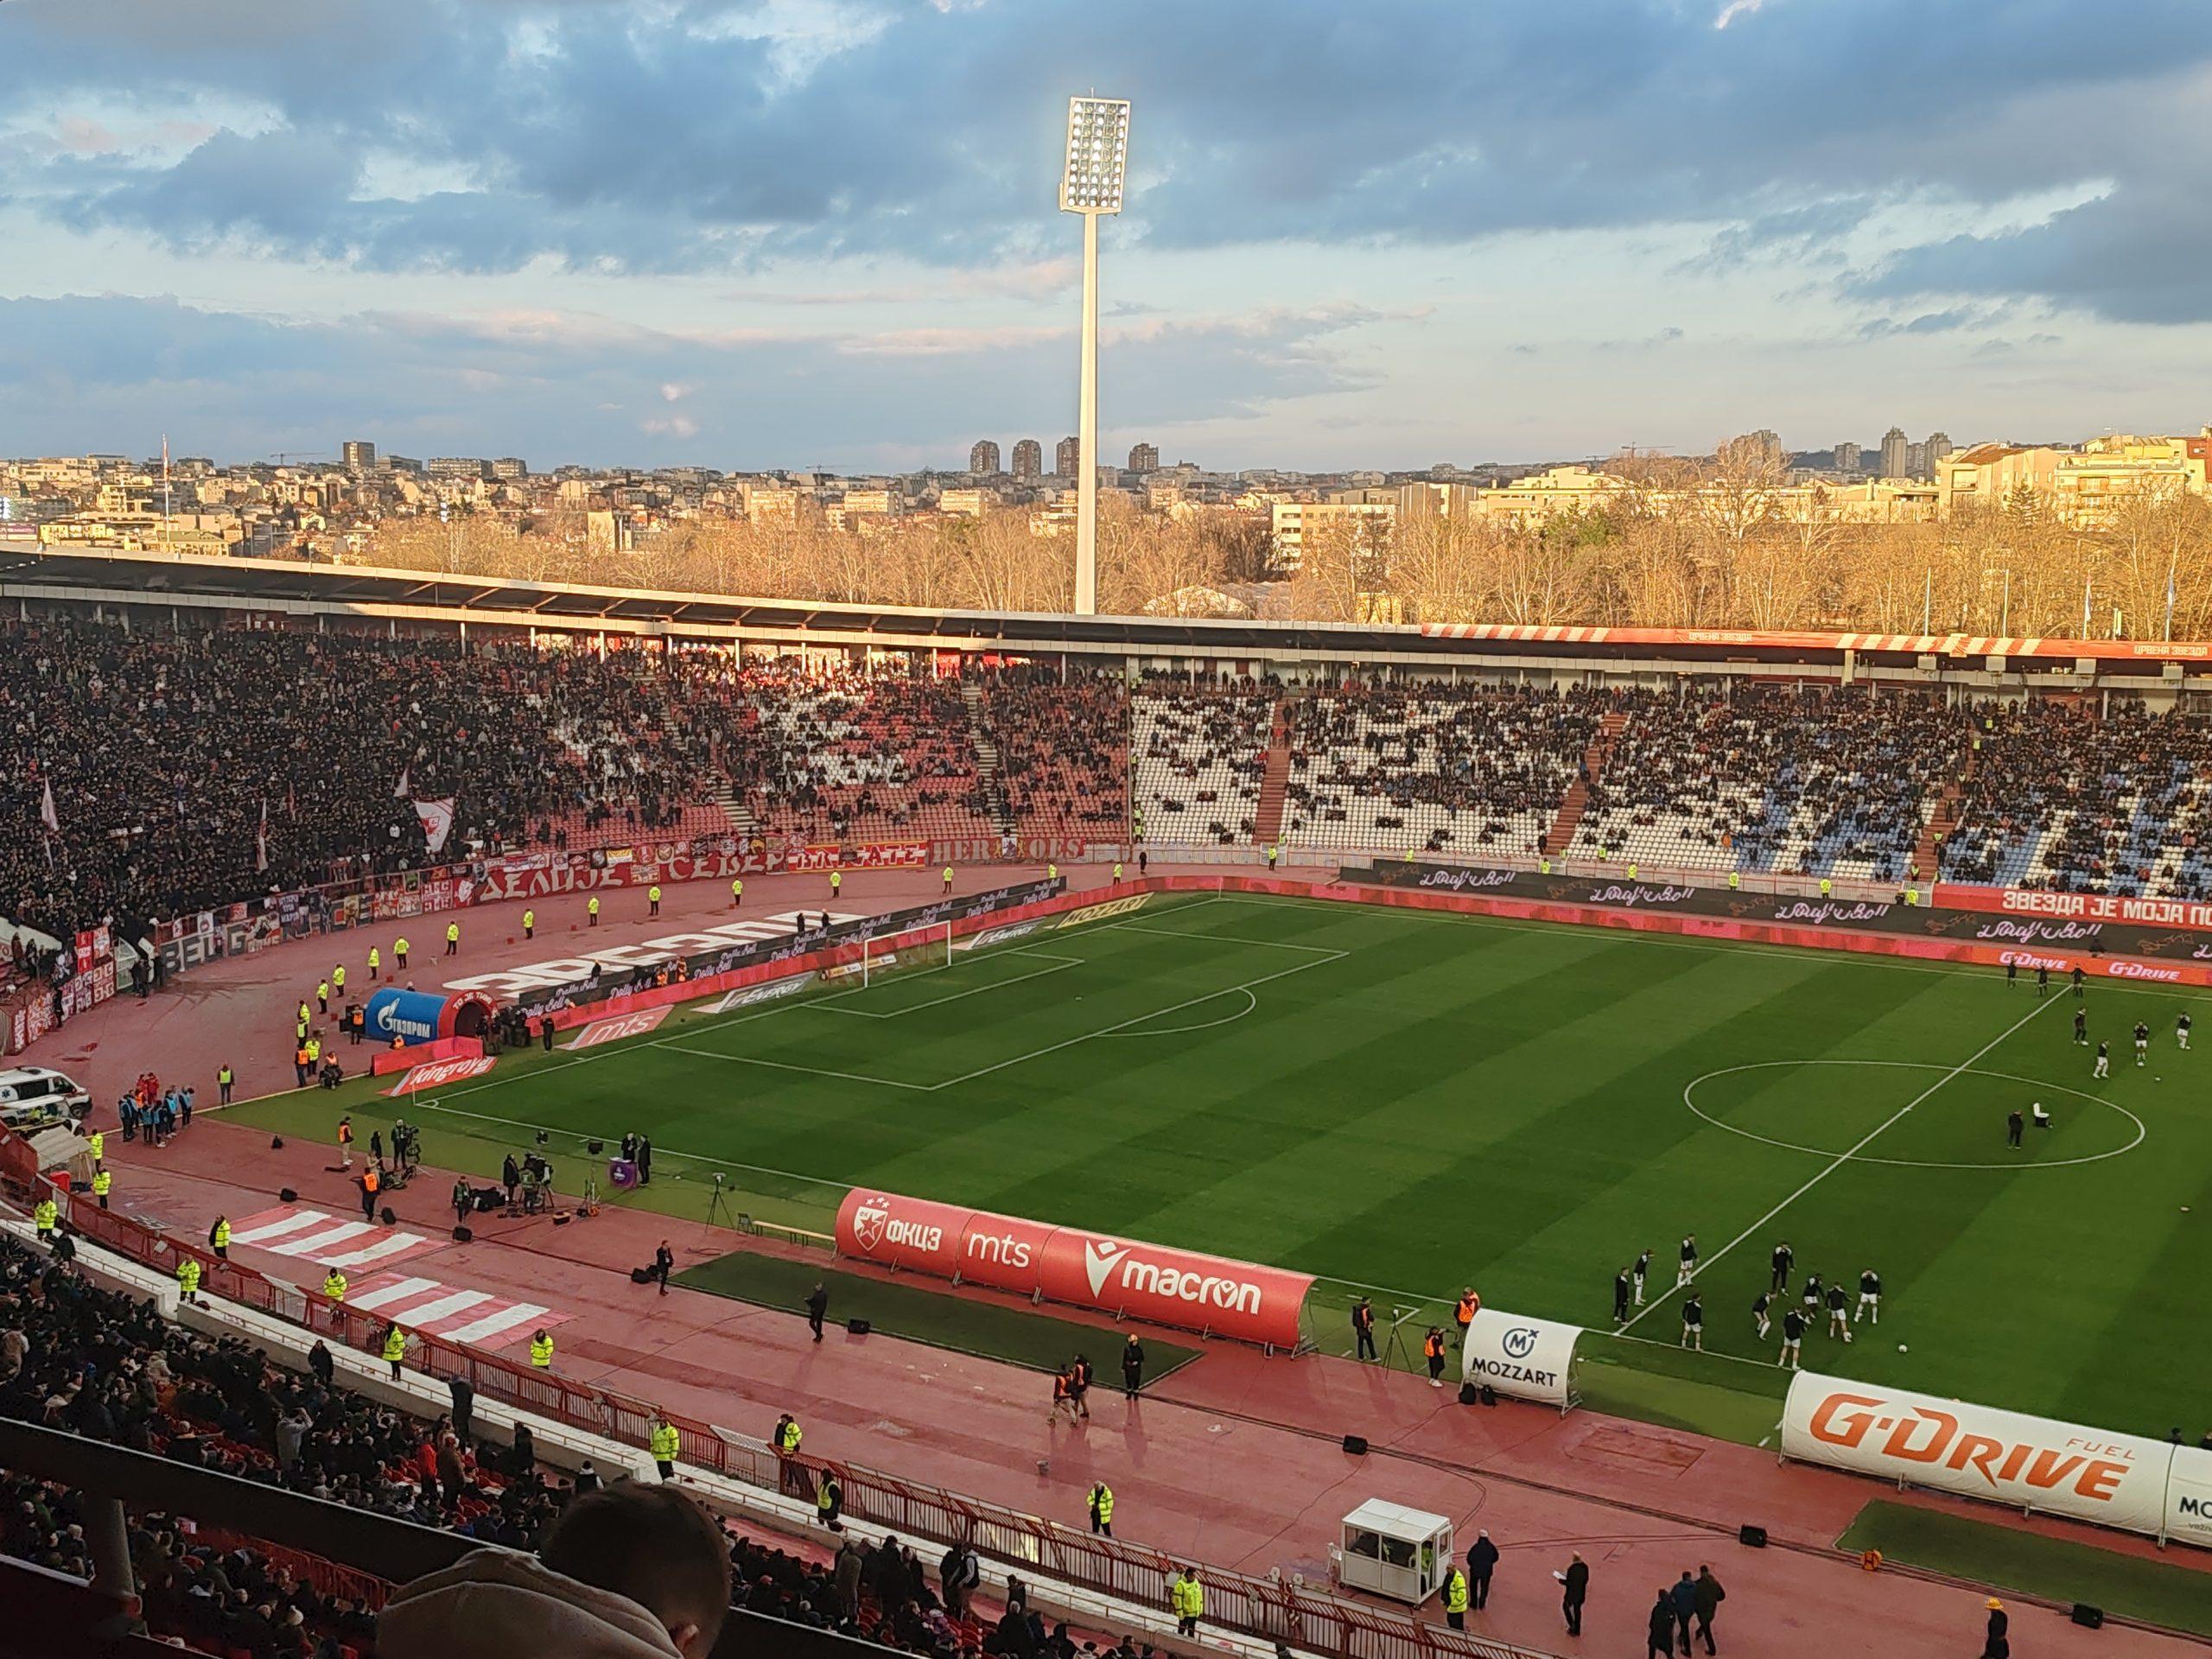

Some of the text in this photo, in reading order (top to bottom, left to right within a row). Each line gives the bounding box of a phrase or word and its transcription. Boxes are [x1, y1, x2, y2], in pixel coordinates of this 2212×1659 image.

[2133, 645, 2208, 657] ЦРВЕНА ЗВЕЗДА
[1063, 895, 1149, 923] MOZZART
[2002, 890, 2084, 916] ЗВЕЗДА
[2091, 897, 2119, 918] ЈЕ
[2123, 900, 2183, 924] МОЈА
[634, 977, 652, 993] Bll
[392, 1020, 430, 1039] ГАЗПРОМ
[588, 1014, 655, 1046] mts
[886, 1219, 942, 1252] ФКЦЗ
[967, 1232, 1032, 1268] mts
[1122, 1260, 1262, 1315] macron
[1471, 1357, 1557, 1387] MOZZART
[2065, 1438, 2136, 1460] FUEL
